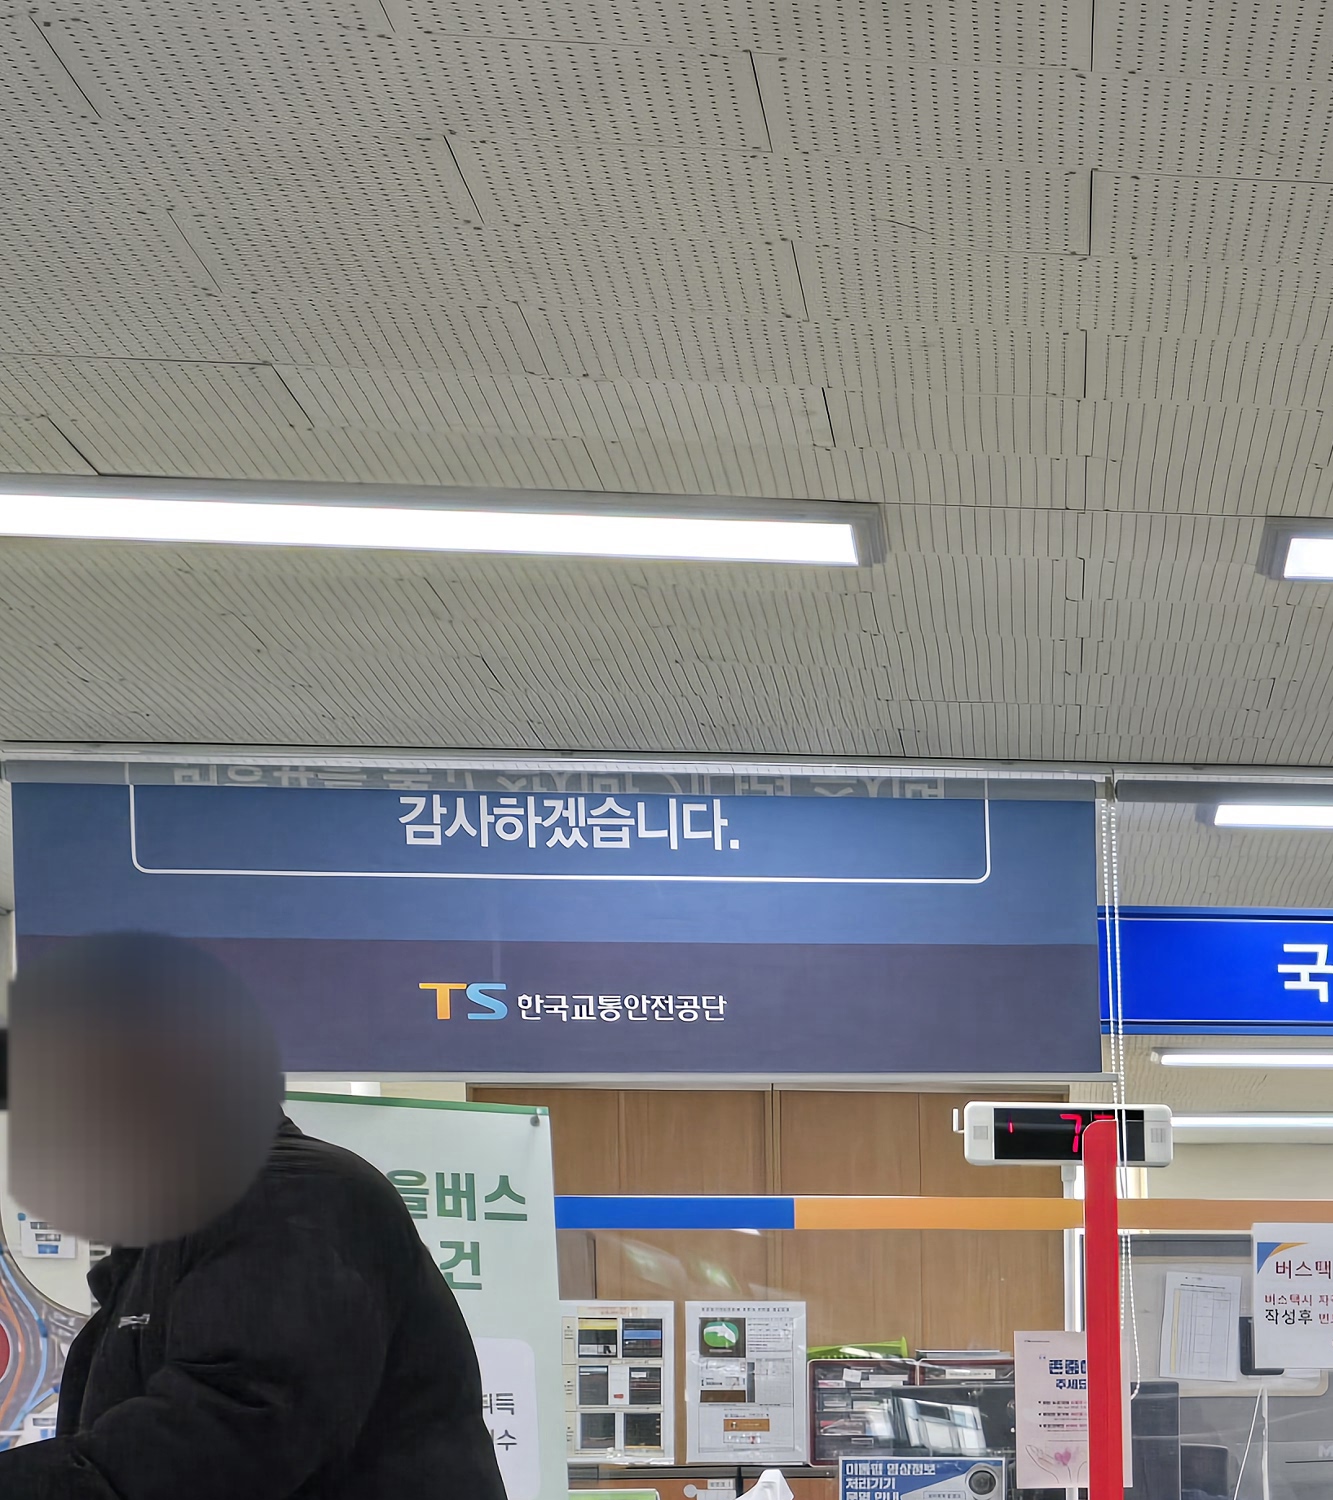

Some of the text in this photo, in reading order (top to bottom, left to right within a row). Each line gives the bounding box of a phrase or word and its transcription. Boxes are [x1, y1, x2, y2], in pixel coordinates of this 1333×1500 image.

[397, 793, 740, 851] 감사하겠습니다.
[418, 982, 728, 1022] TS 한국교통안전공단
[439, 1240, 483, 1291] 건
[1265, 1308, 1313, 1326] 작성후
